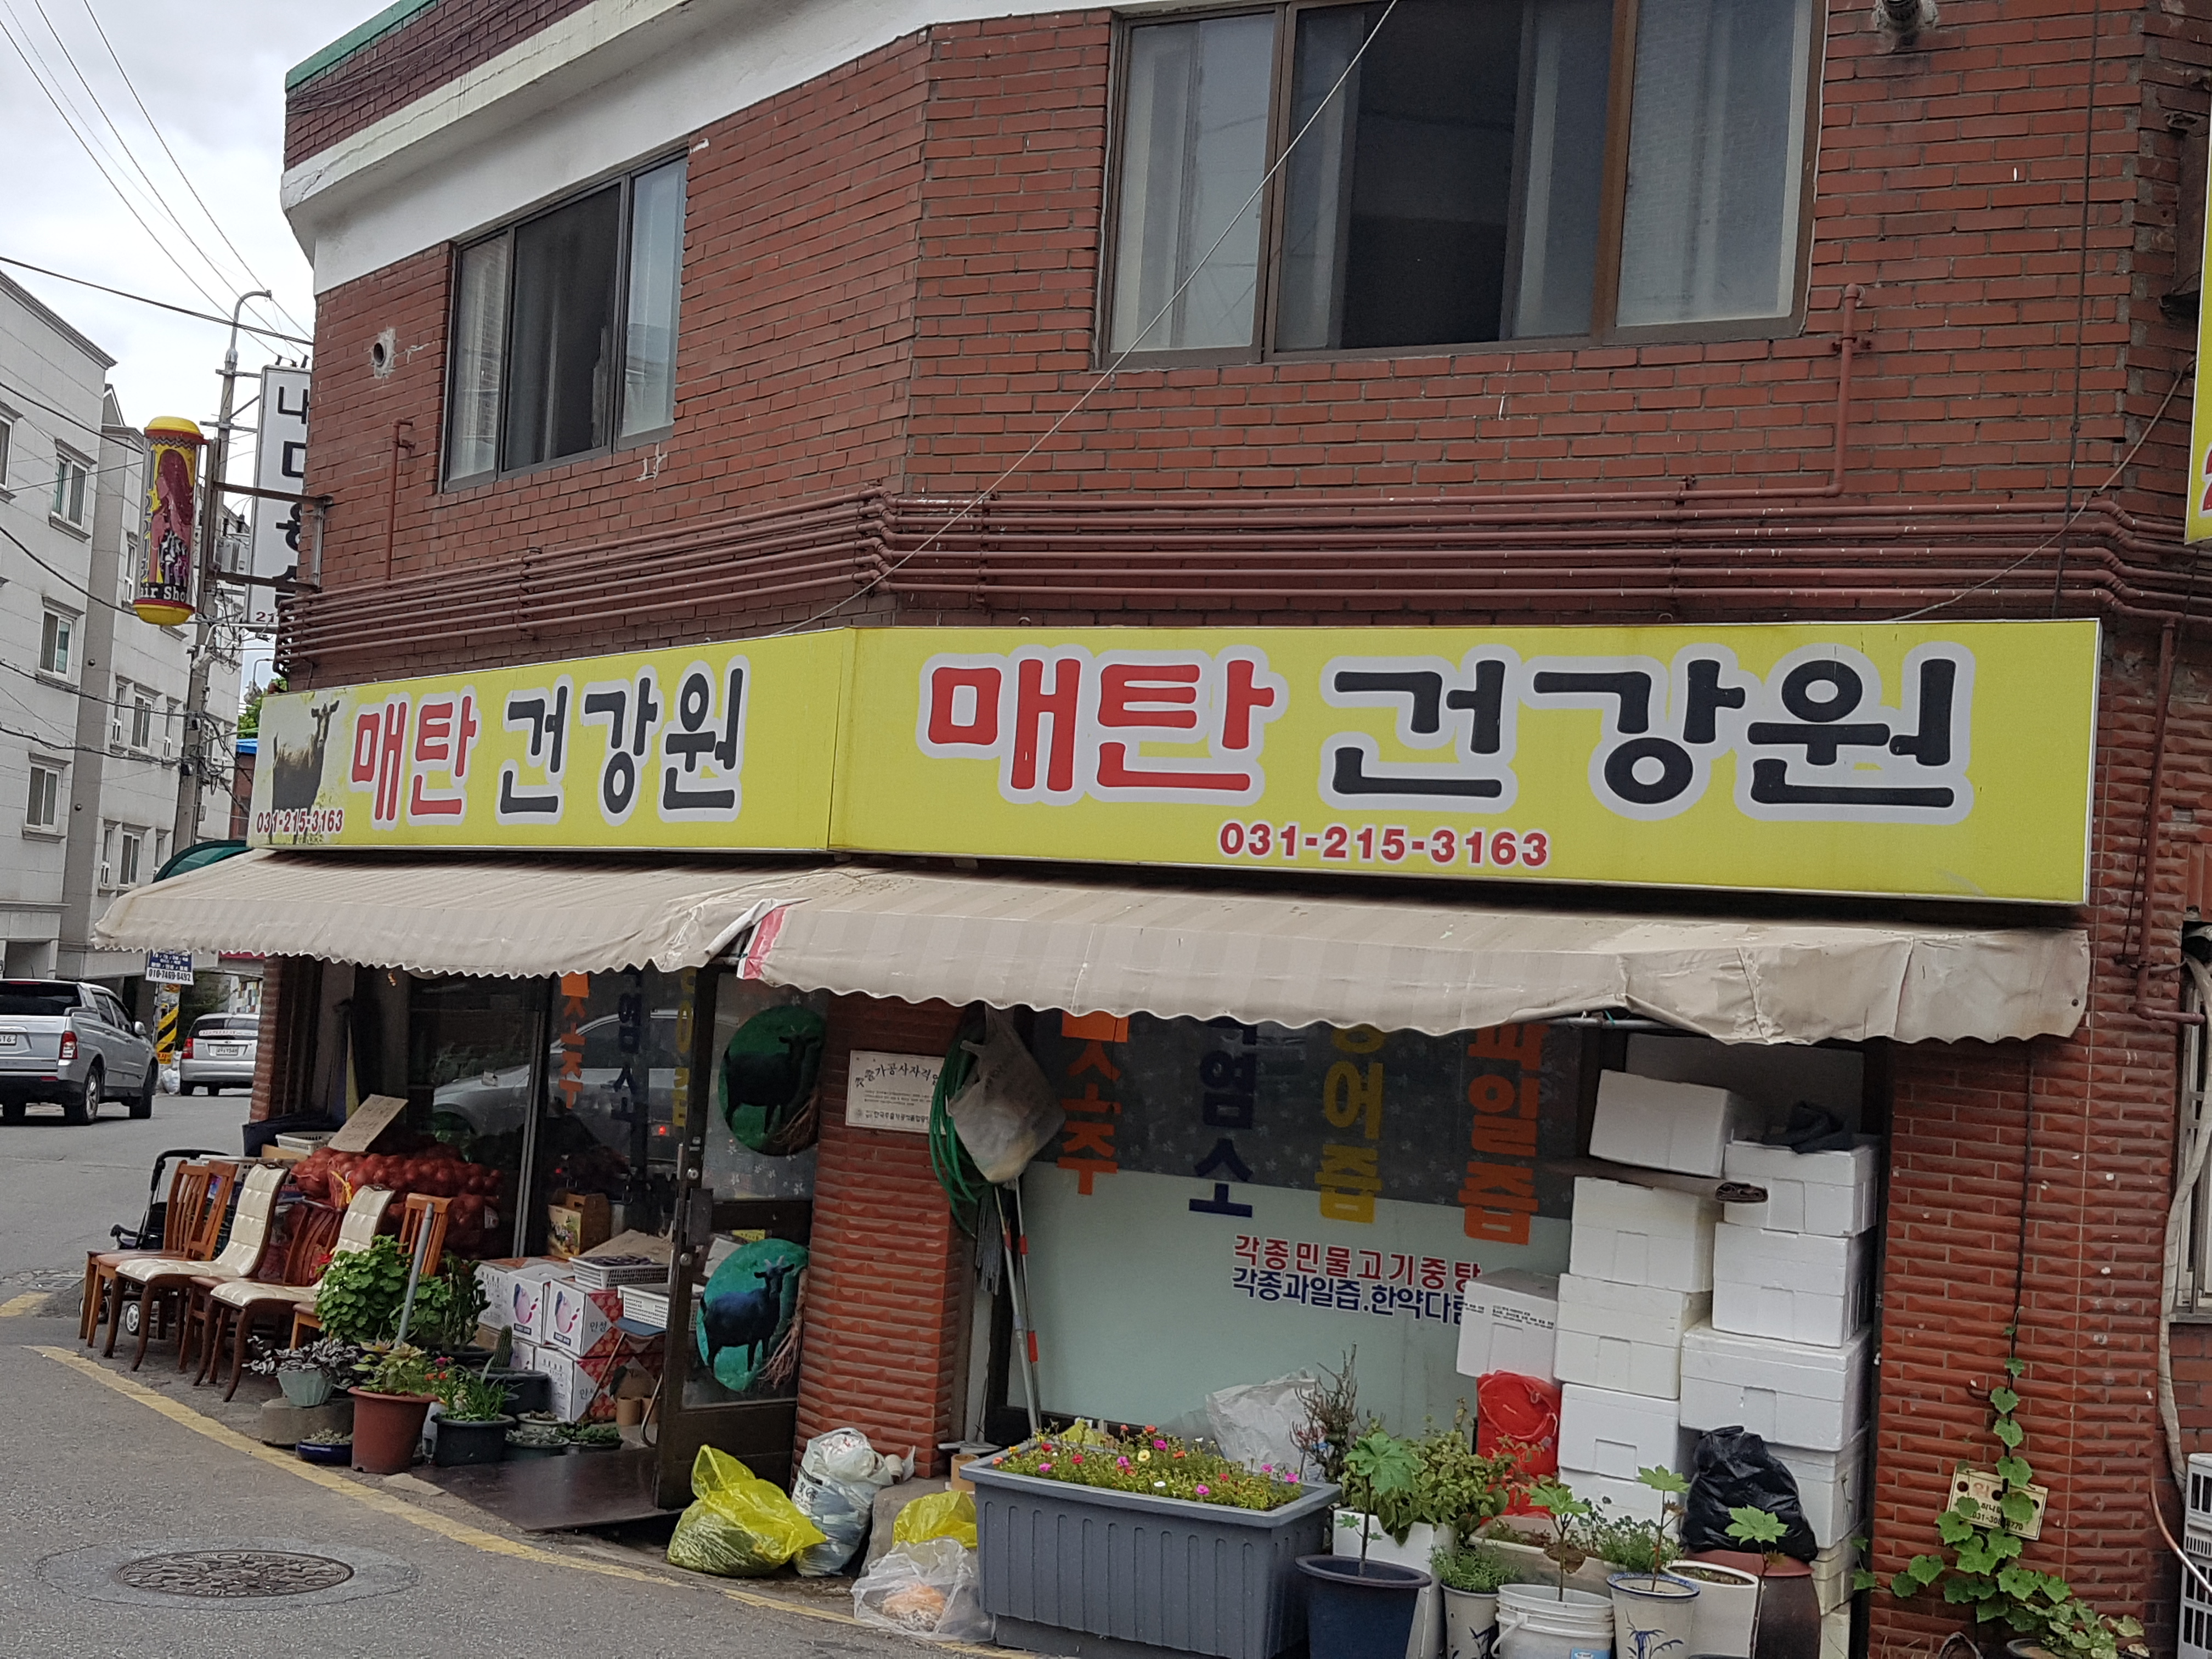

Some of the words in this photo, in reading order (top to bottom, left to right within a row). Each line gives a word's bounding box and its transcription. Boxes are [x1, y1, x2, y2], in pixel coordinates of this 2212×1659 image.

[352, 695, 477, 821] 매탄
[499, 668, 744, 815] 건강원
[929, 656, 1274, 792] 매탄
[1334, 658, 1954, 808] 건강원
[256, 809, 343, 833] 031-215-3163
[1220, 822, 1547, 866] 031-215-3163
